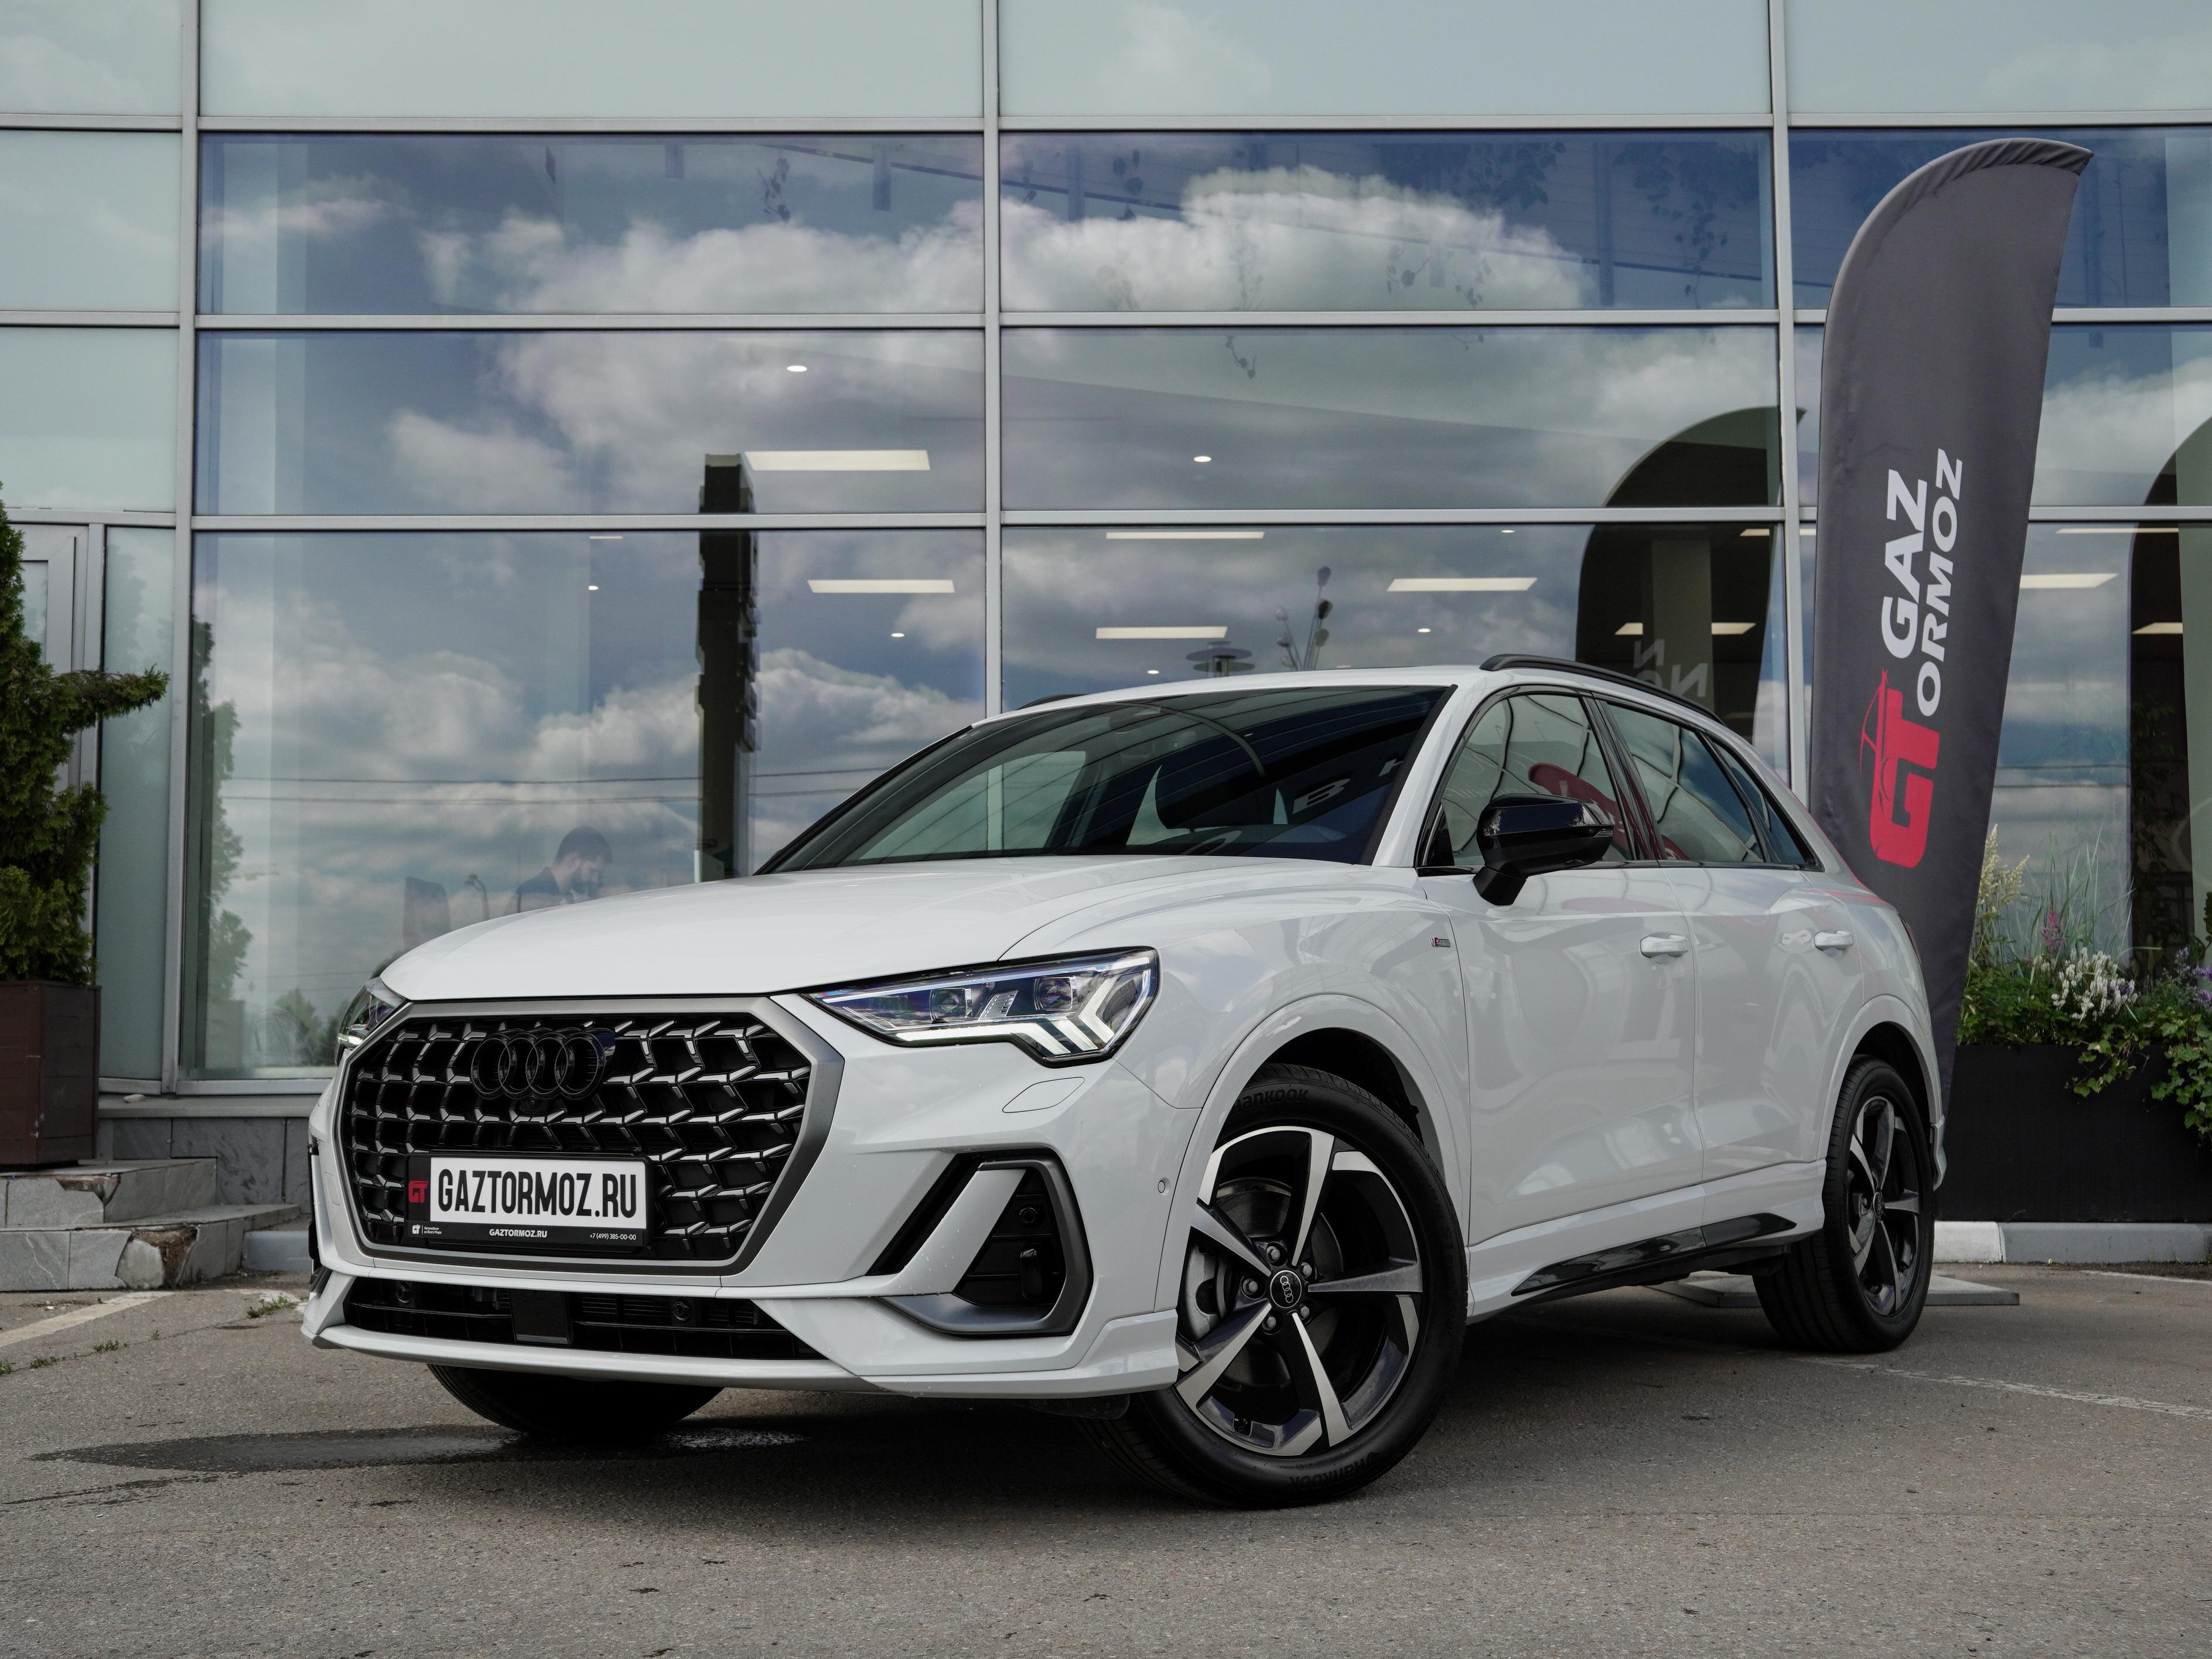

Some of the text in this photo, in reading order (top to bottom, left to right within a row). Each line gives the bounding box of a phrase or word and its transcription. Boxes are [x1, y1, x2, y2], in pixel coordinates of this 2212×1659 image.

[1881, 469, 1927, 658] GAZ
[1917, 448, 1962, 716] ORMOZ
[408, 1180, 429, 1203] GT
[438, 1169, 637, 1218] GAZTORMOZ.RU
[489, 1229, 548, 1238] GAZTORMOZ.RU
